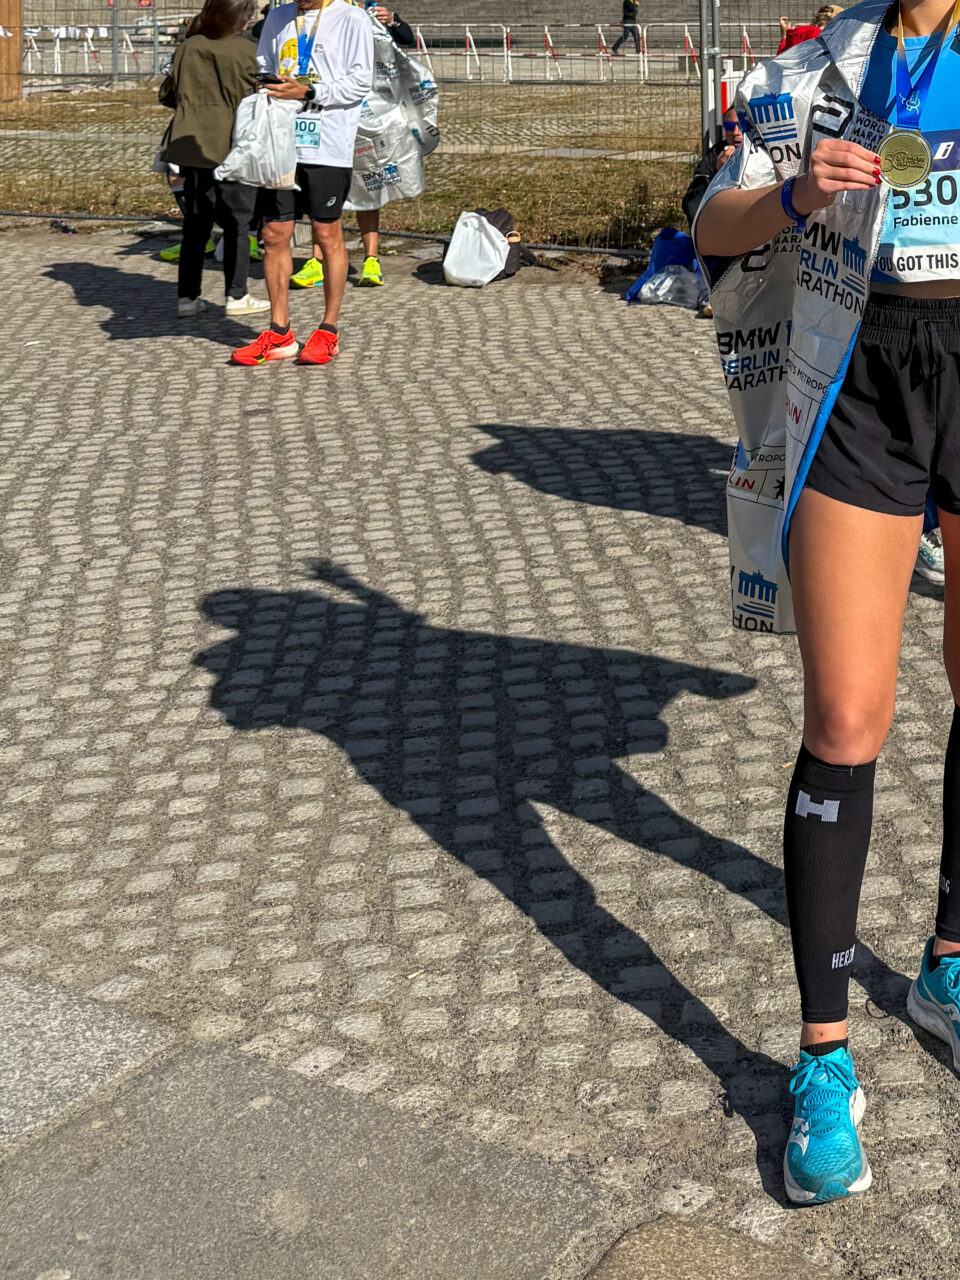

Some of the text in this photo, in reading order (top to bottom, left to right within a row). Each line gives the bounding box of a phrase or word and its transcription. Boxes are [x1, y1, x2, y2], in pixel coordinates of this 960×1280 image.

[856, 115, 886, 135] WORLD
[893, 214, 958, 229] Fabienne
[896, 254, 924, 272] GOT
[926, 253, 959, 270] THIS
[797, 267, 865, 318] RATHON
[717, 321, 781, 355] BMW
[725, 366, 788, 392] ARATH
